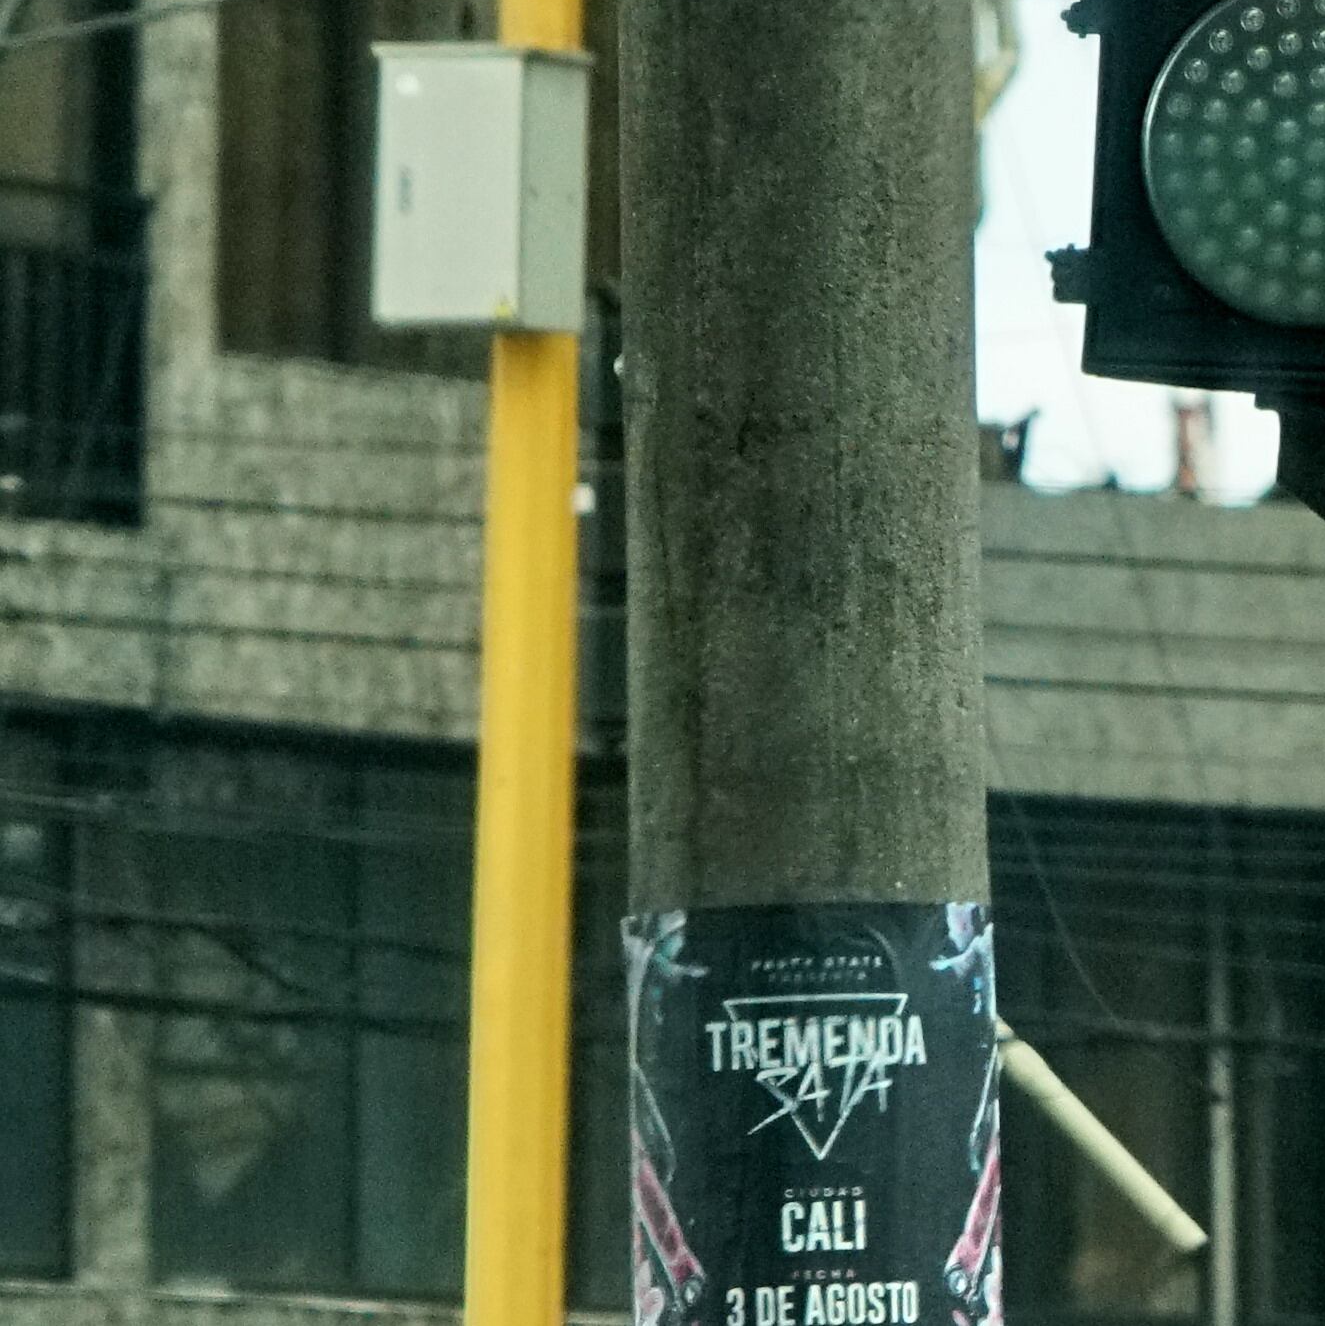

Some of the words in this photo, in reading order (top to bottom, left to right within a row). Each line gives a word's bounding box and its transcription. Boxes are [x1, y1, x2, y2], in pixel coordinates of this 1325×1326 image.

[704, 1014, 927, 1072] TREMENDA
[783, 1186, 865, 1199] CIUDAD
[780, 1200, 867, 1253] CALI
[725, 1286, 746, 1326] 3
[755, 1285, 797, 1326] DE
[804, 1280, 920, 1326] AGOSTO
